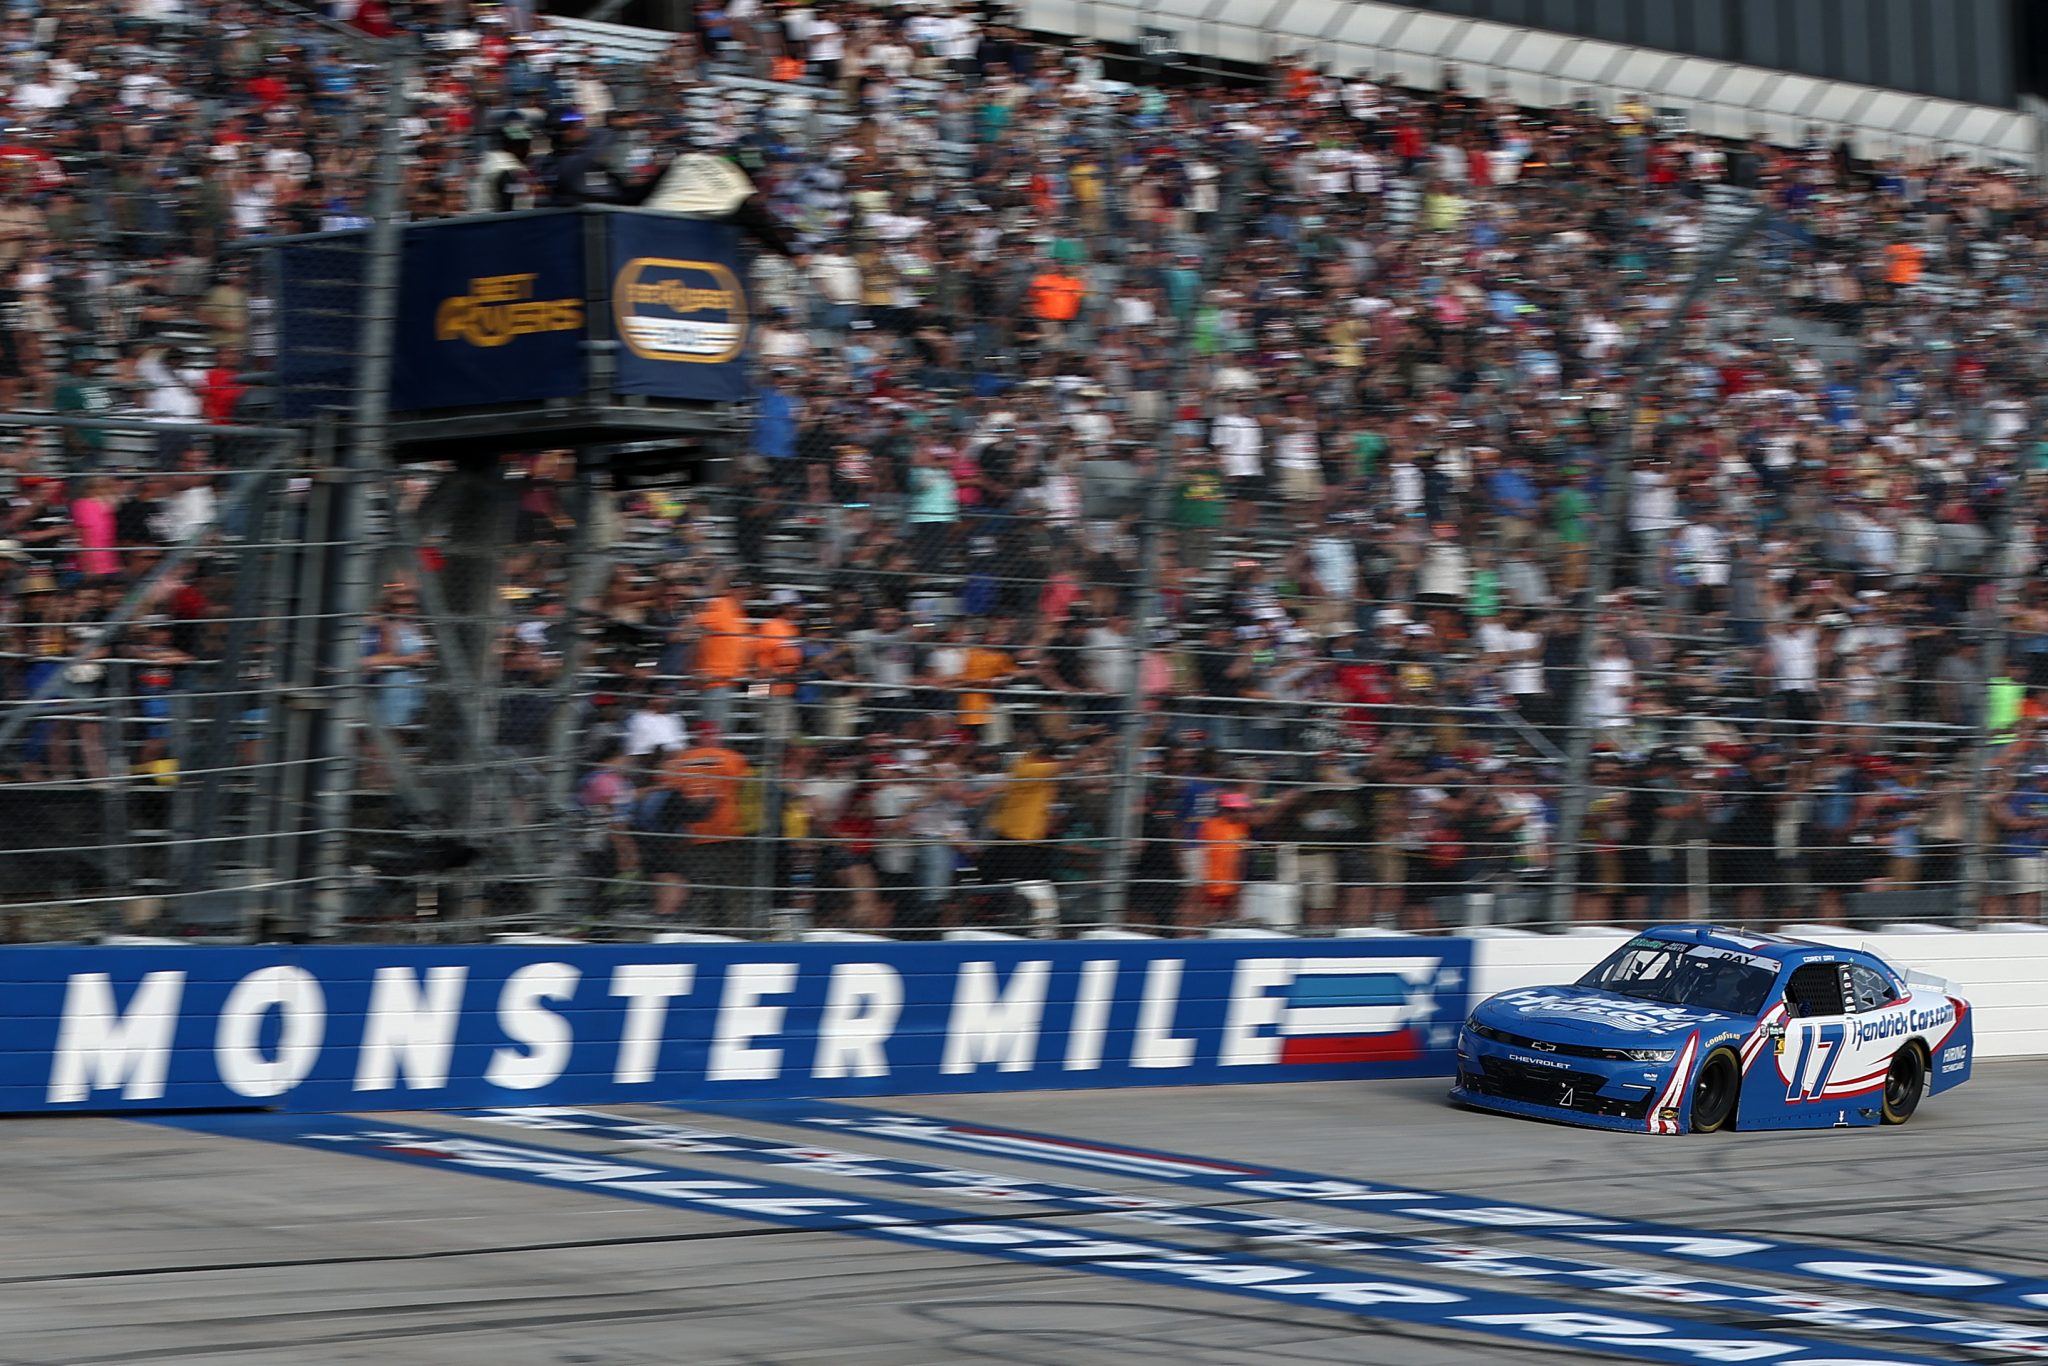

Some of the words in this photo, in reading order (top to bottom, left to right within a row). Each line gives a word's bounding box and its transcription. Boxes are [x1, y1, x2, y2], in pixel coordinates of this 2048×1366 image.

[1719, 953, 1757, 965] DAY
[46, 962, 905, 1104] MONSTER
[938, 957, 1293, 1075] MILE
[1704, 1031, 1741, 1048] GOODYEAR
[1509, 1054, 1571, 1069] CHEVROLET
[1786, 1023, 1847, 1103] 17
[1224, 1180, 2048, 1307] OVER
